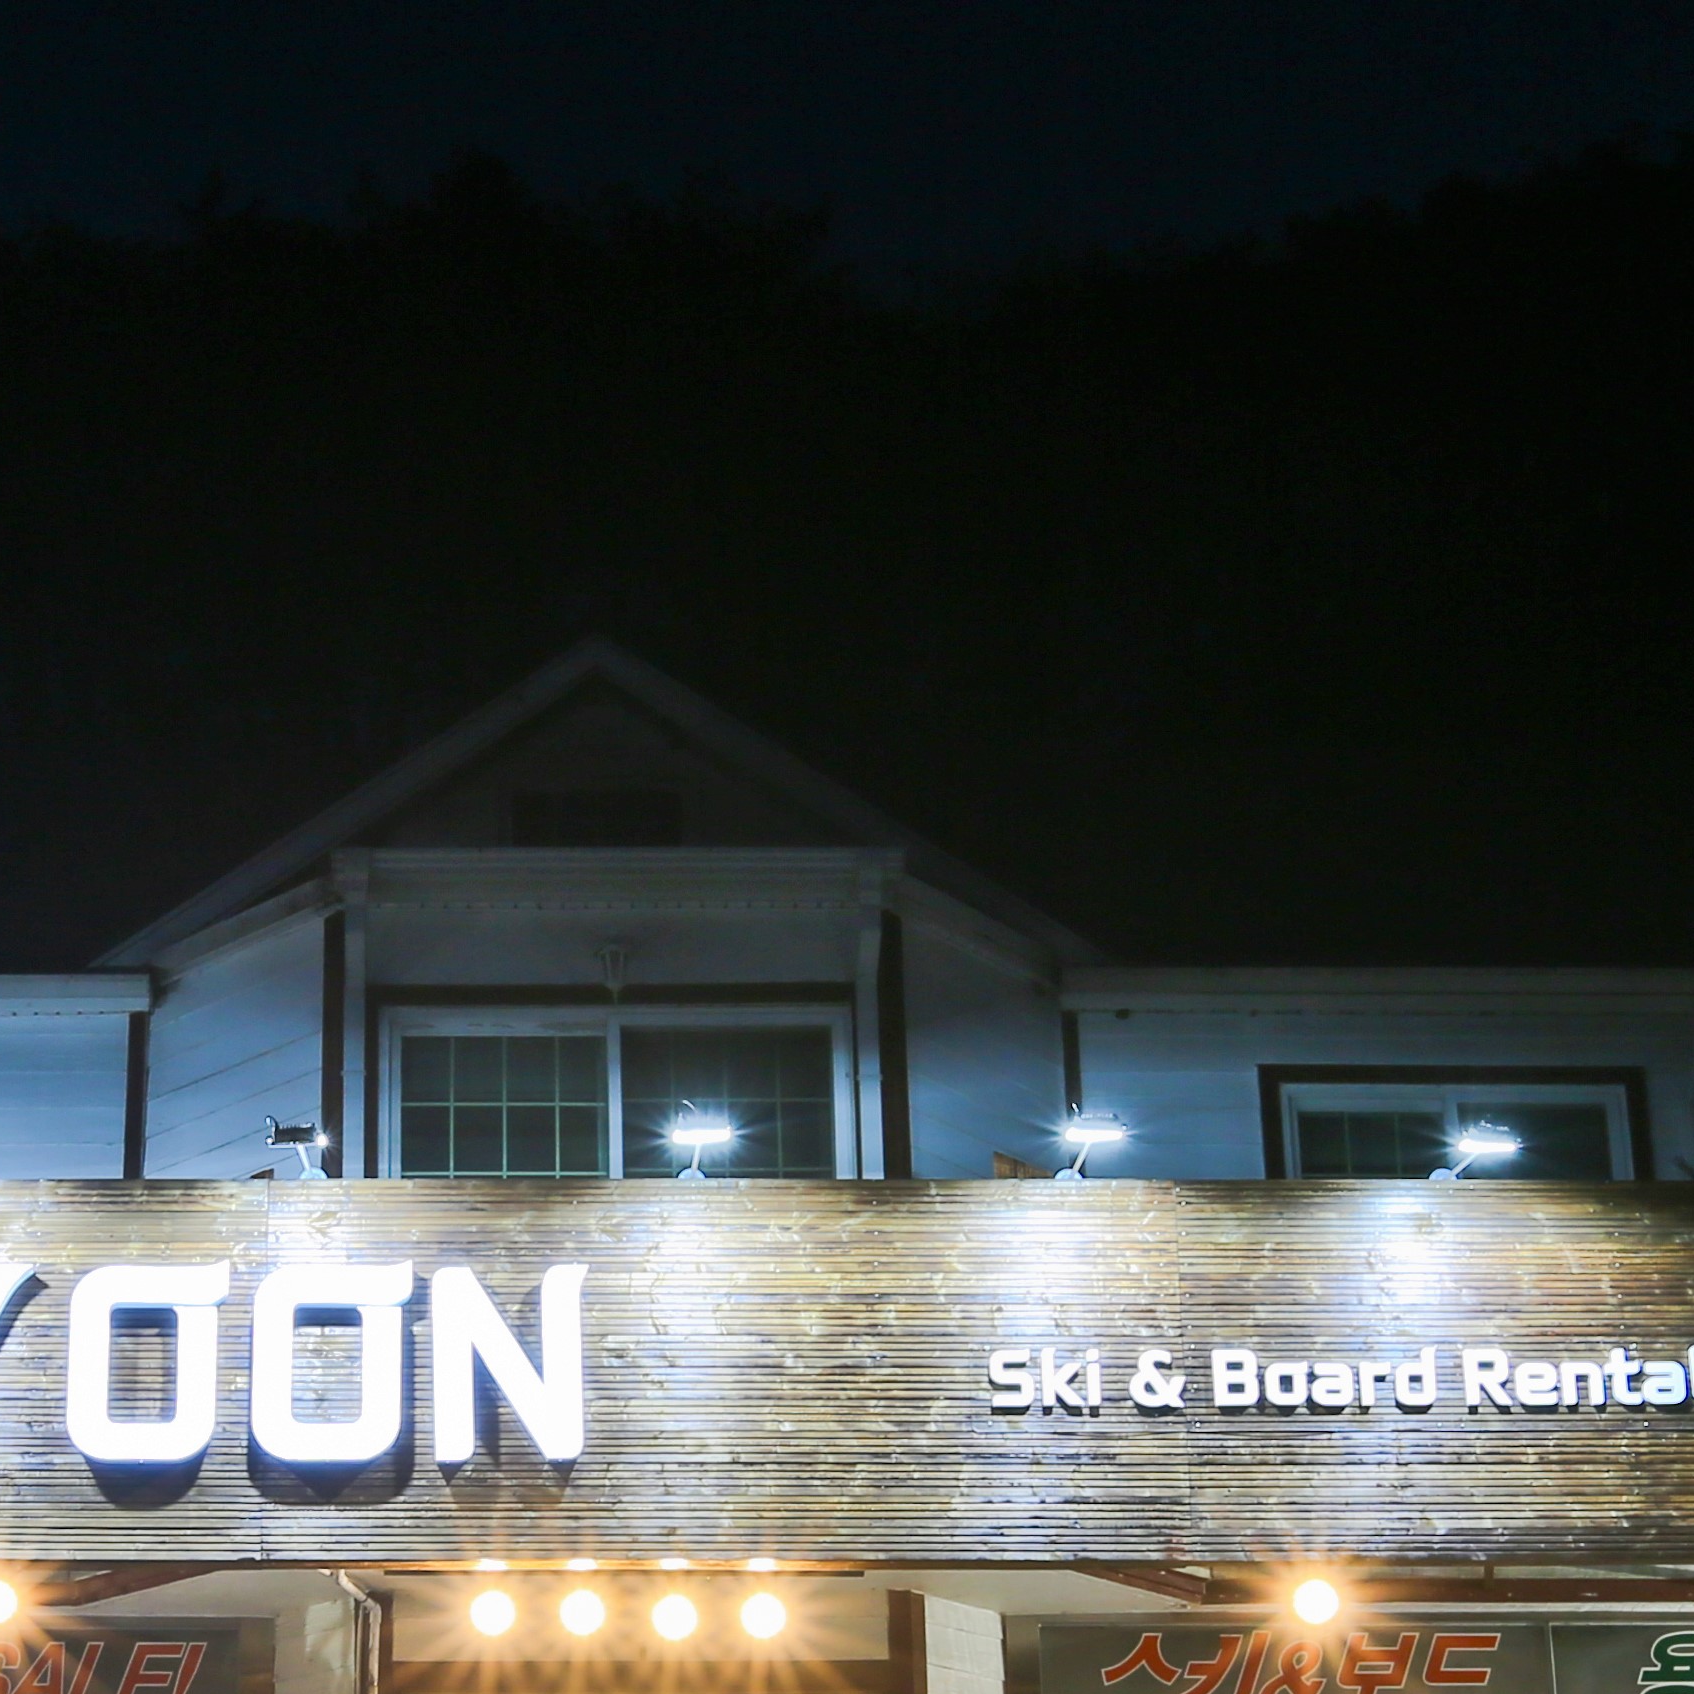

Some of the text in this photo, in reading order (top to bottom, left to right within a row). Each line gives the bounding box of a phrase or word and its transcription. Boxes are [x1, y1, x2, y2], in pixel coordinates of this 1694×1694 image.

[987, 1346, 1101, 1409] Ski
[1127, 1349, 1187, 1409] &
[1210, 1345, 1439, 1408] Board
